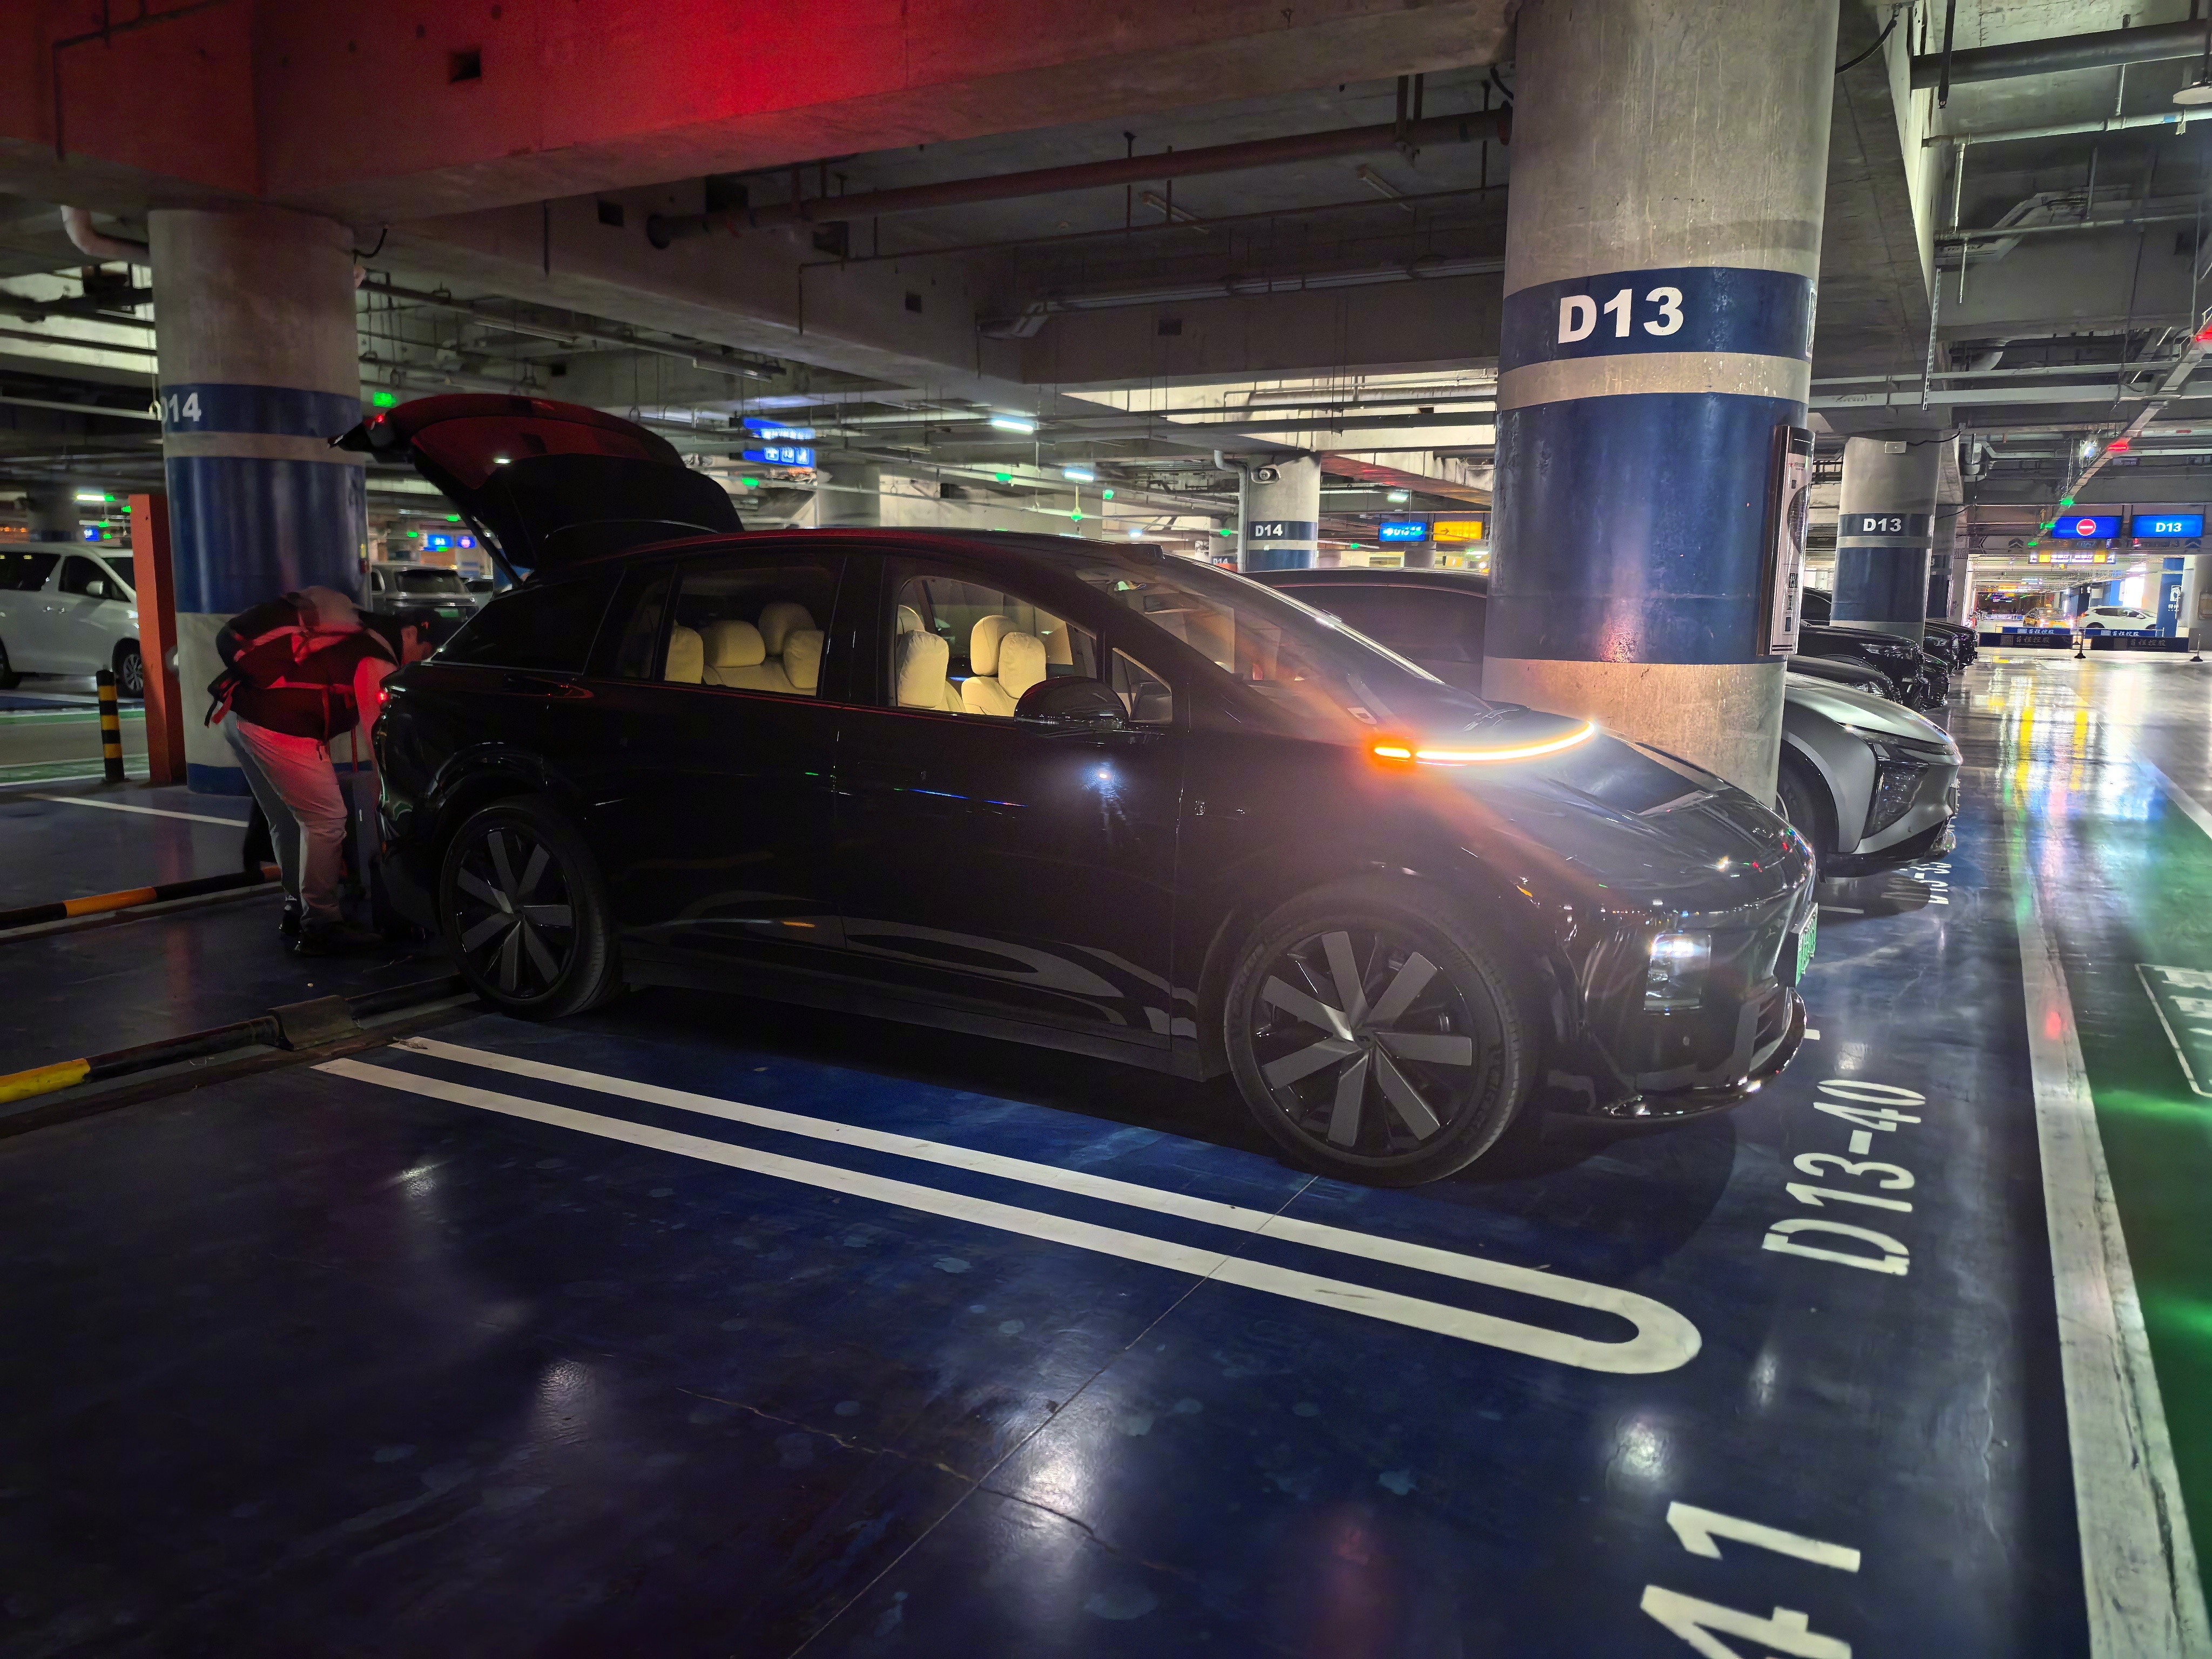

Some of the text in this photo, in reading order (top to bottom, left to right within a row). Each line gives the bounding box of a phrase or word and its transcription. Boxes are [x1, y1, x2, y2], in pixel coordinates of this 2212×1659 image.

[1557, 287, 1684, 344] D13
[1255, 524, 1283, 537] D14
[1863, 518, 1902, 532] D13
[2155, 522, 2182, 532] D13
[1761, 1078, 1926, 1277] D13-40
